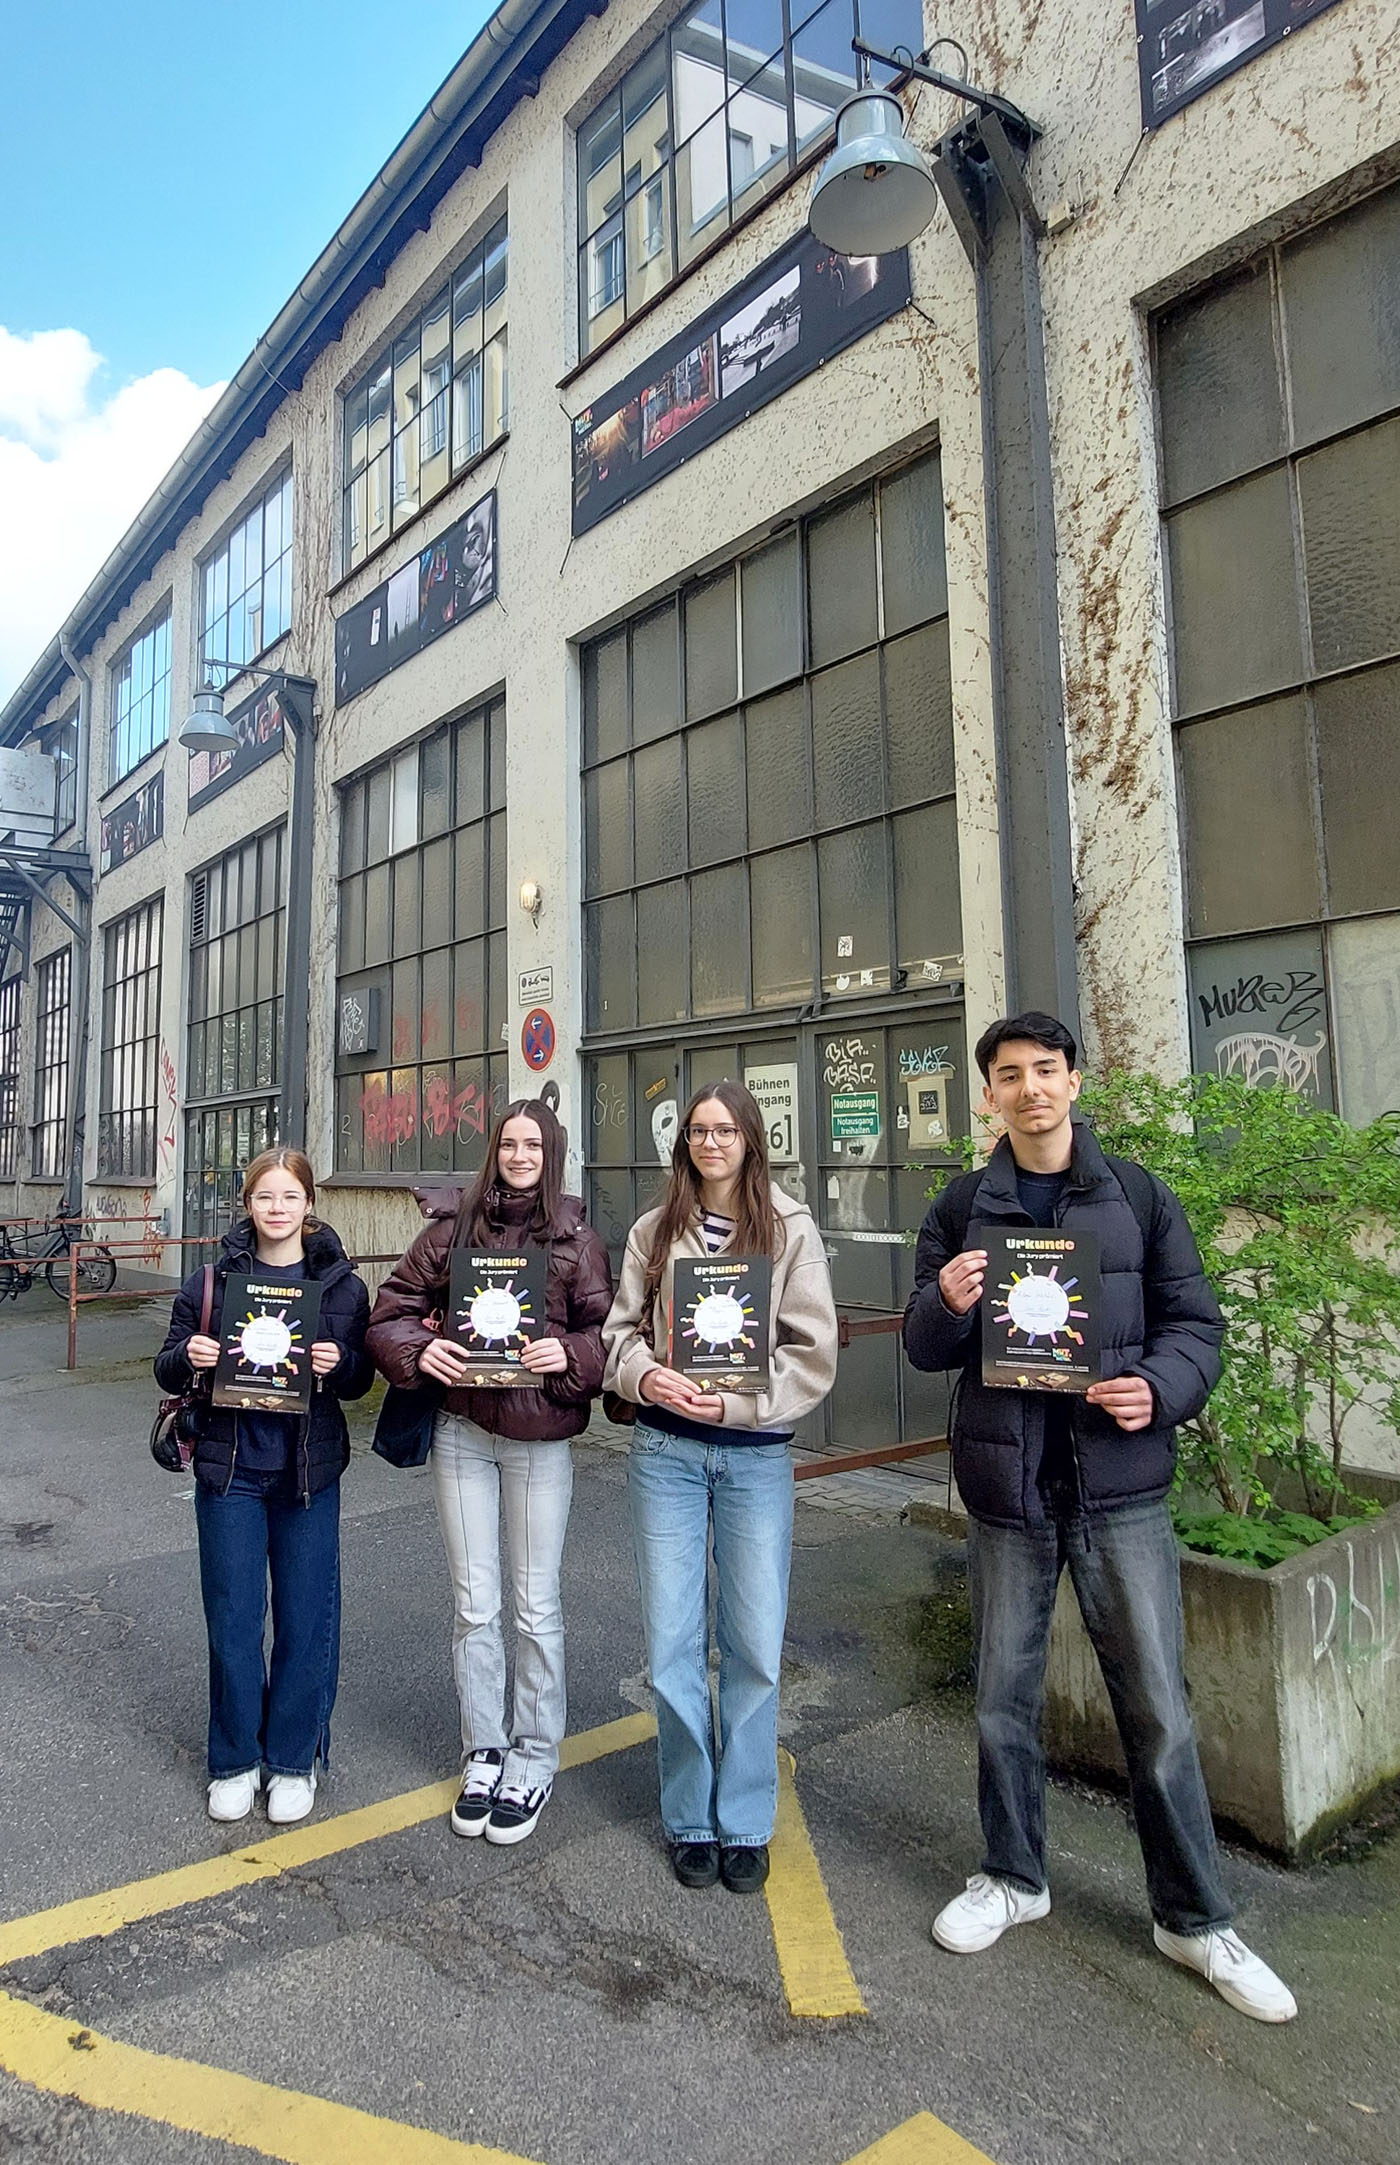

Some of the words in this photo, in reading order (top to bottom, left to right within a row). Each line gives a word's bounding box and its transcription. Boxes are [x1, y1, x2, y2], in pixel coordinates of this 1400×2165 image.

[748, 1079, 790, 1091] Bühnen
[834, 1098, 876, 1109] Notausgang
[837, 1117, 874, 1127] Notausgang
[840, 1125, 871, 1135] freihalten
